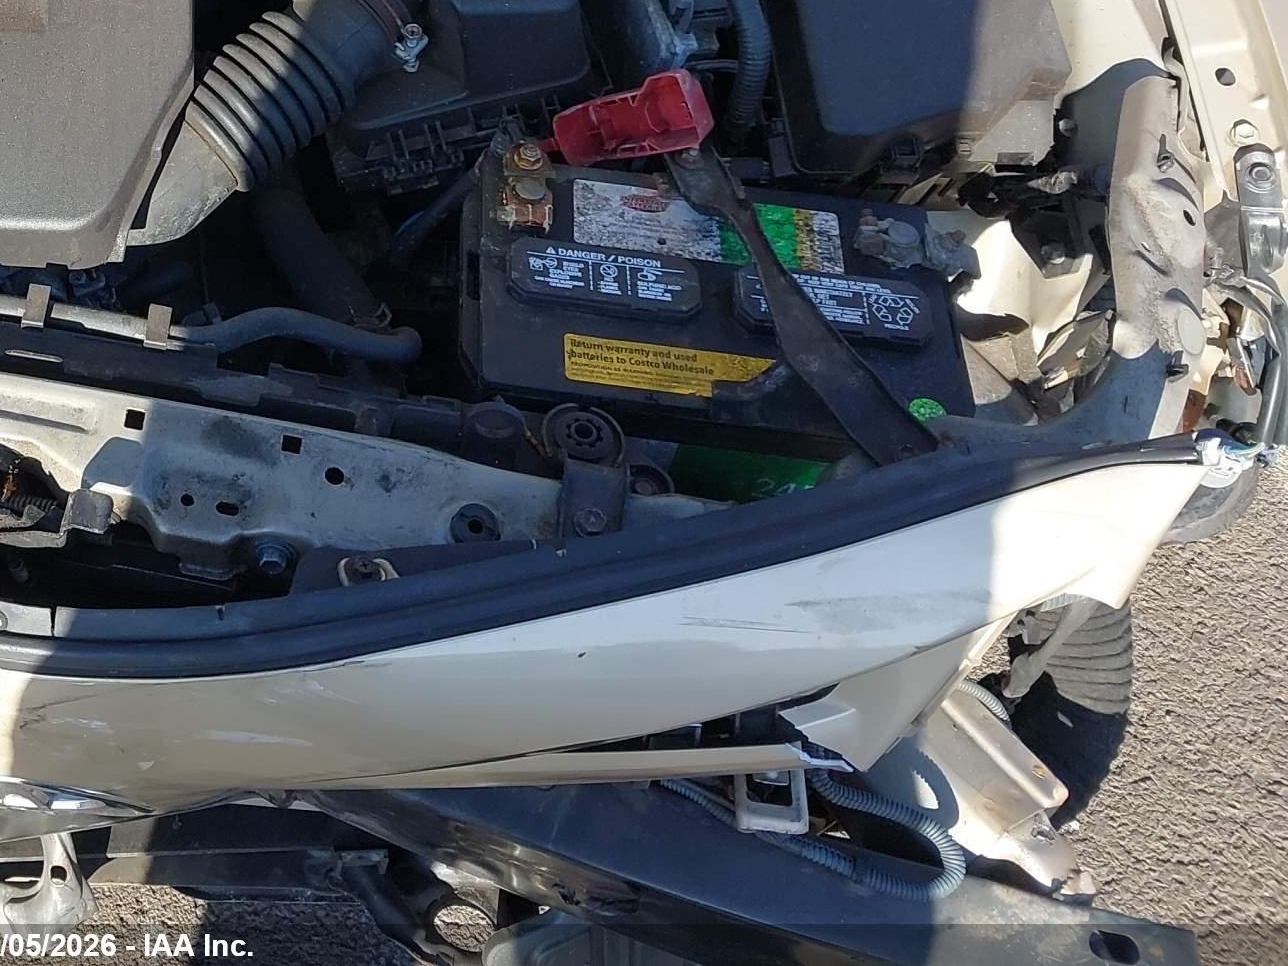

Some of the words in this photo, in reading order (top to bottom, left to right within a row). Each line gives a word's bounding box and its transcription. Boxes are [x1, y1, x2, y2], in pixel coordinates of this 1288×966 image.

[558, 247, 606, 262] DANGER
[607, 254, 616, 262] /
[617, 255, 662, 268] POISON
[570, 338, 604, 351] Return
[605, 345, 650, 359] warranty
[652, 350, 671, 360] and
[673, 353, 698, 363] used
[570, 349, 614, 364] batteries
[616, 356, 627, 364] to
[629, 357, 660, 369] Costco
[663, 362, 714, 375] Wholesale
